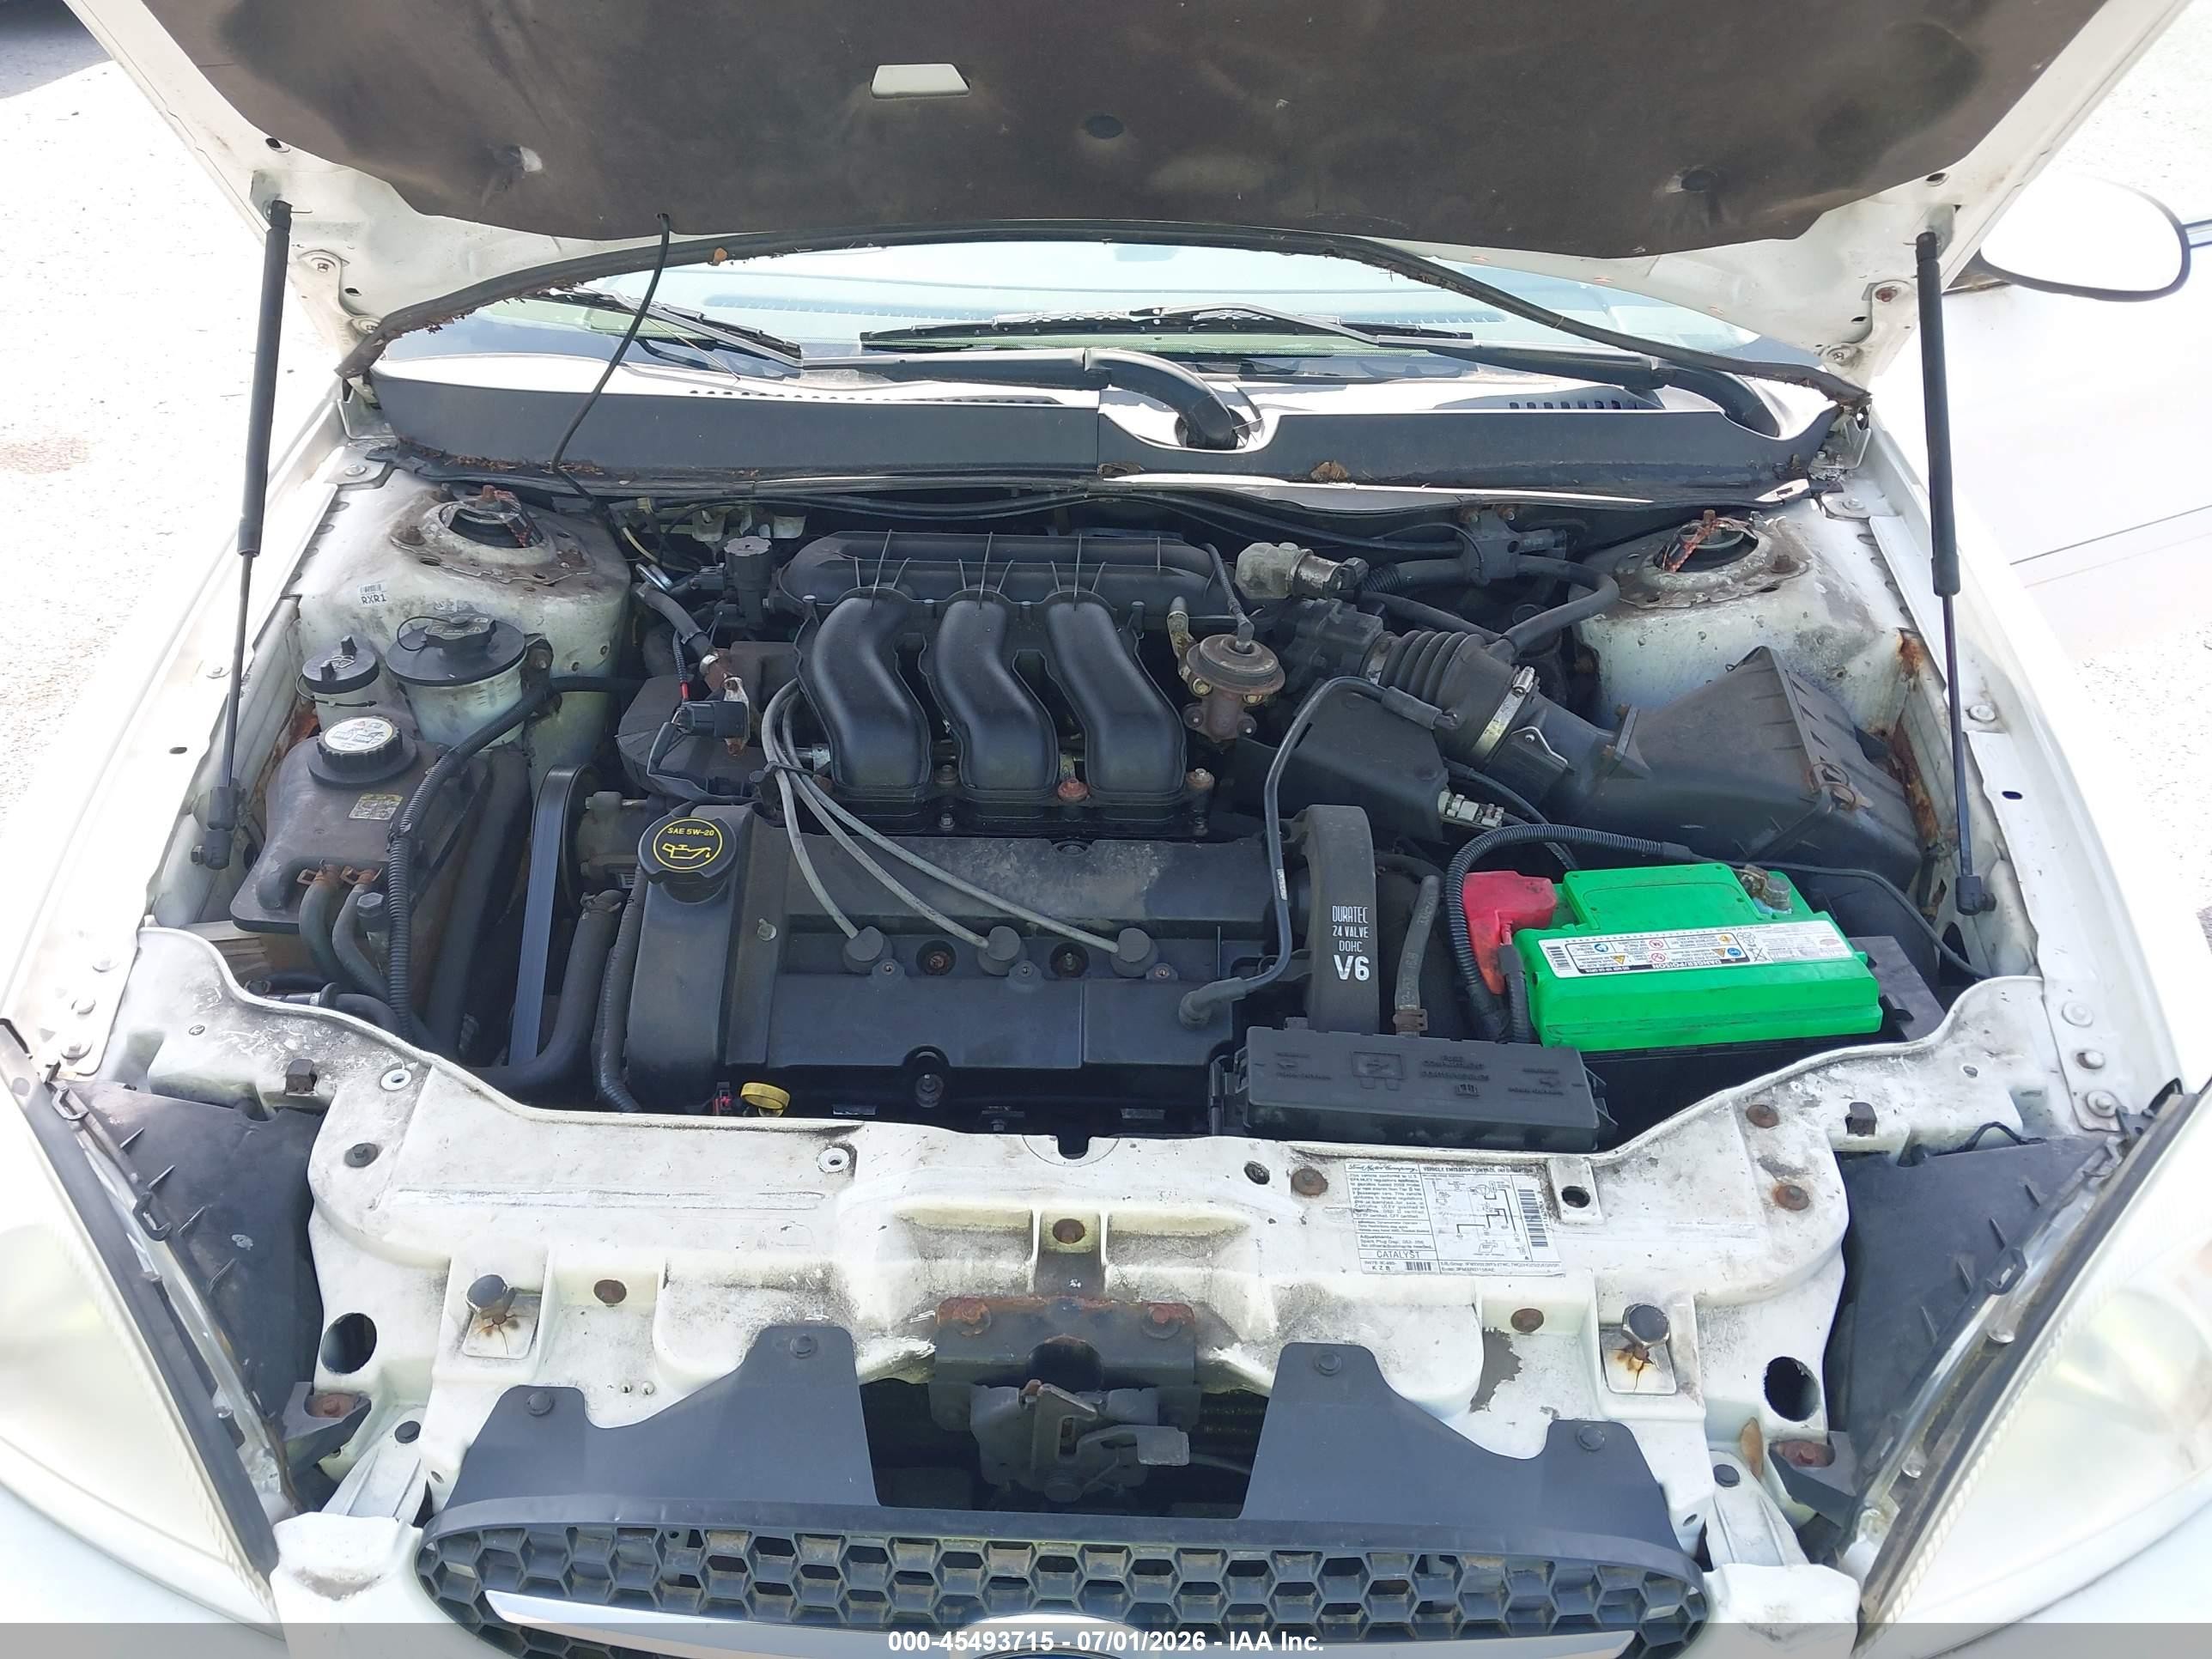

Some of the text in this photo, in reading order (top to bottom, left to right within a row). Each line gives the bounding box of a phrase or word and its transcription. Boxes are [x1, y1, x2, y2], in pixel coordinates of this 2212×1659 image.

[361, 593, 387, 605] RXR1
[686, 828, 714, 836] 5W-20
[1332, 905, 1369, 924] DURATEC
[1332, 925, 1369, 939] 24 VALVE
[1339, 940, 1364, 952] DOHC
[1333, 954, 1370, 981] V6
